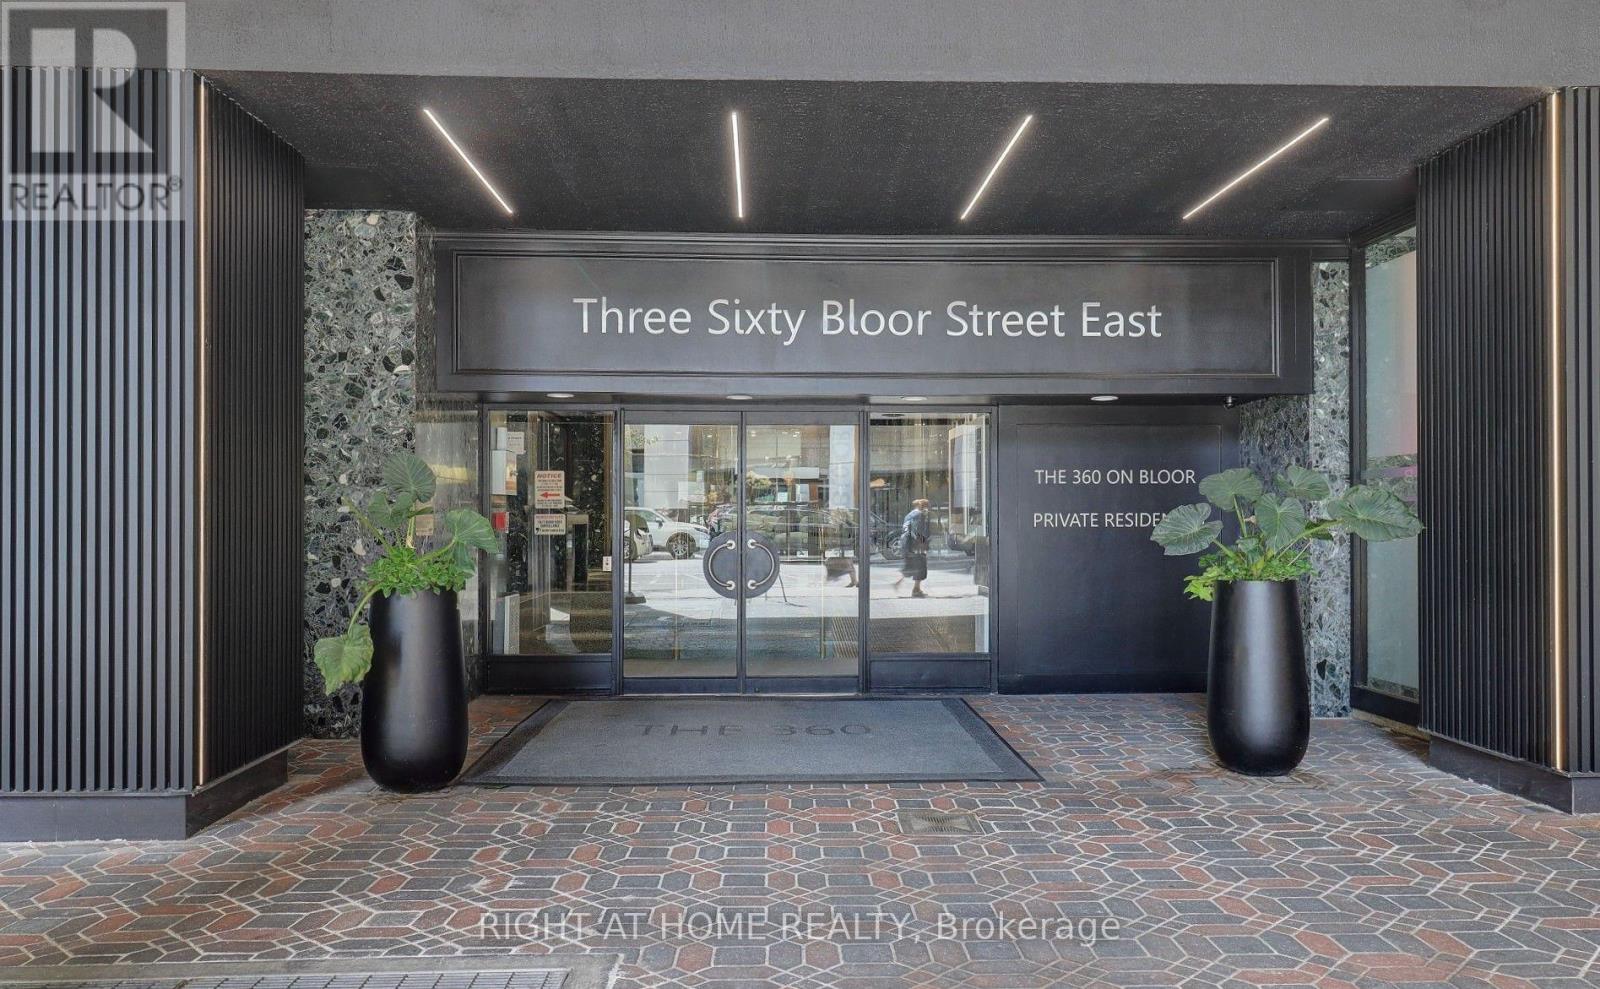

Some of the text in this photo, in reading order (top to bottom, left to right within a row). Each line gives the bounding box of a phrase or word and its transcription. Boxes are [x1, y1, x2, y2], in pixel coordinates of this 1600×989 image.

[572, 296, 1163, 346] Three Sixty Bloor Street East
[1034, 469, 1197, 485] THE 360 ON BLOOR
[1033, 512, 1099, 528] PRIVATE
[771, 723, 871, 736] 360
